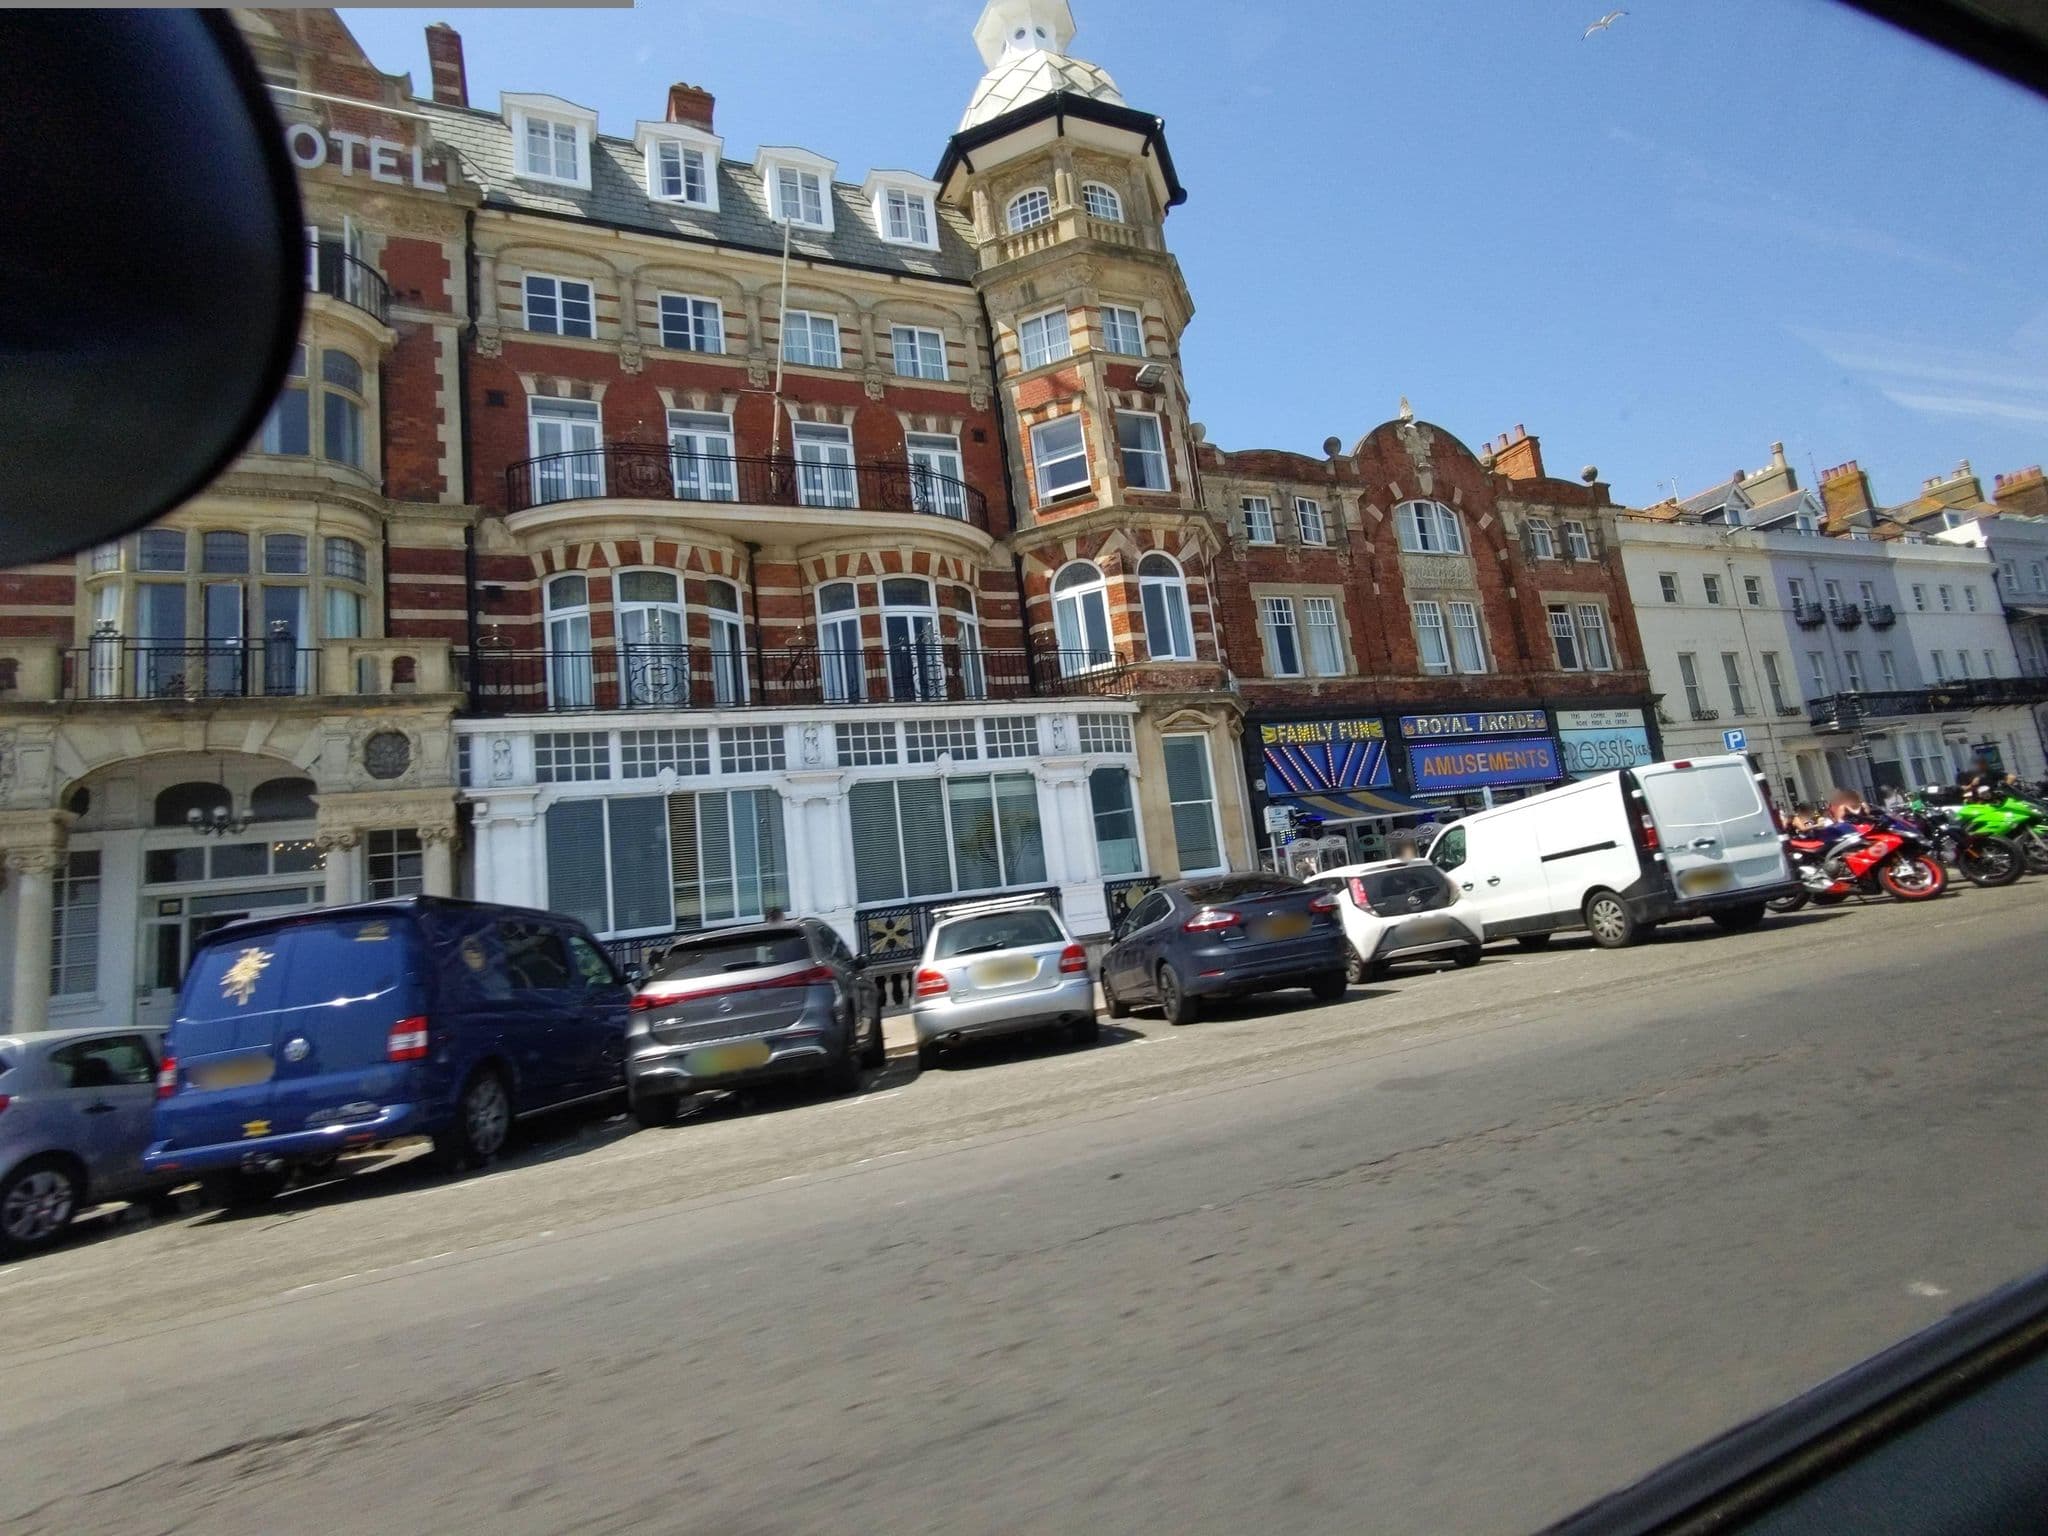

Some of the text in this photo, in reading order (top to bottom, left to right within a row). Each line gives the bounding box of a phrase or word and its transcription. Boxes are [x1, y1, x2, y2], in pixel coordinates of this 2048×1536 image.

[287, 123, 447, 194] OTEL
[1277, 721, 1370, 742] FAMILY FUN
[1416, 713, 1536, 734] ROYAL ARCADE
[1728, 731, 1742, 748] P
[1423, 750, 1549, 777] AMUSEMENTS
